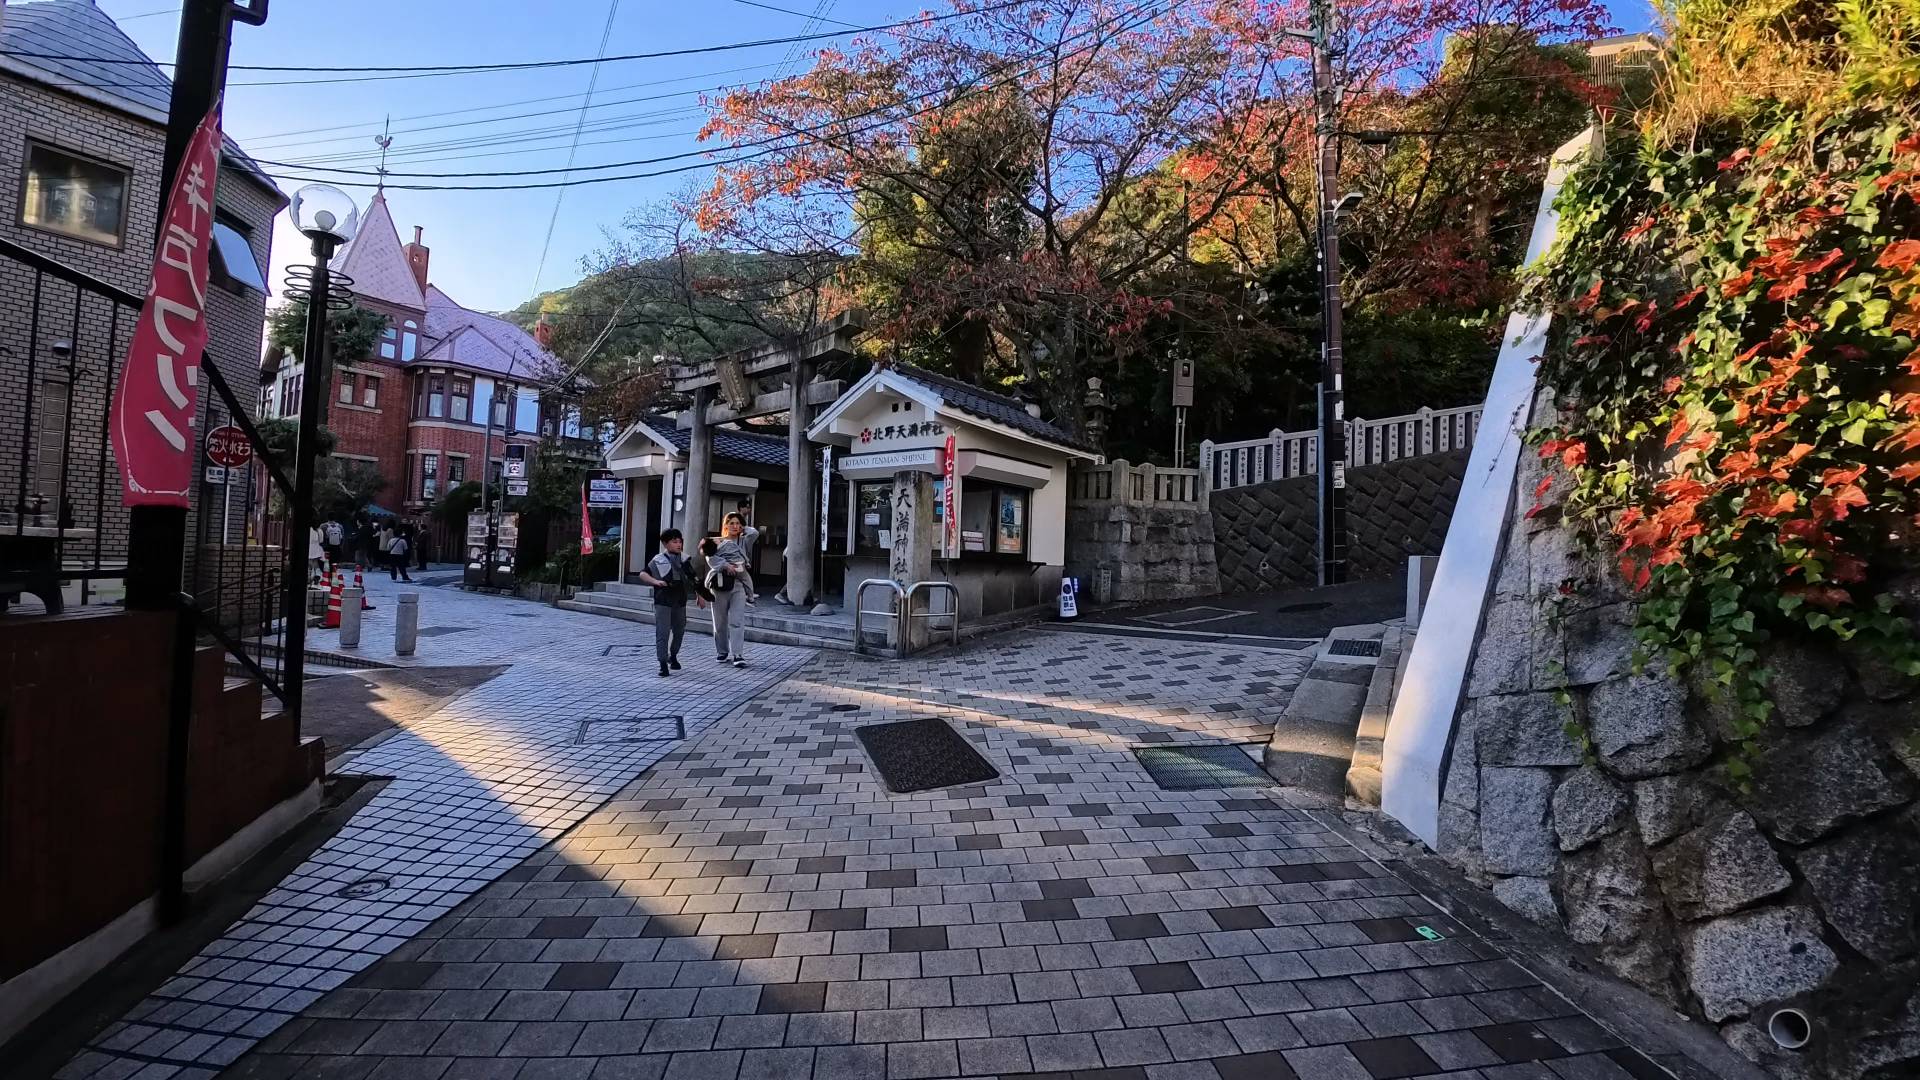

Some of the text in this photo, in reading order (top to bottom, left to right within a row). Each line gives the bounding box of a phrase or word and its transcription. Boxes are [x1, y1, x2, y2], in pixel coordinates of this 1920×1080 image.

[845, 453, 927, 467] KITANO TENMAN SHRINE
